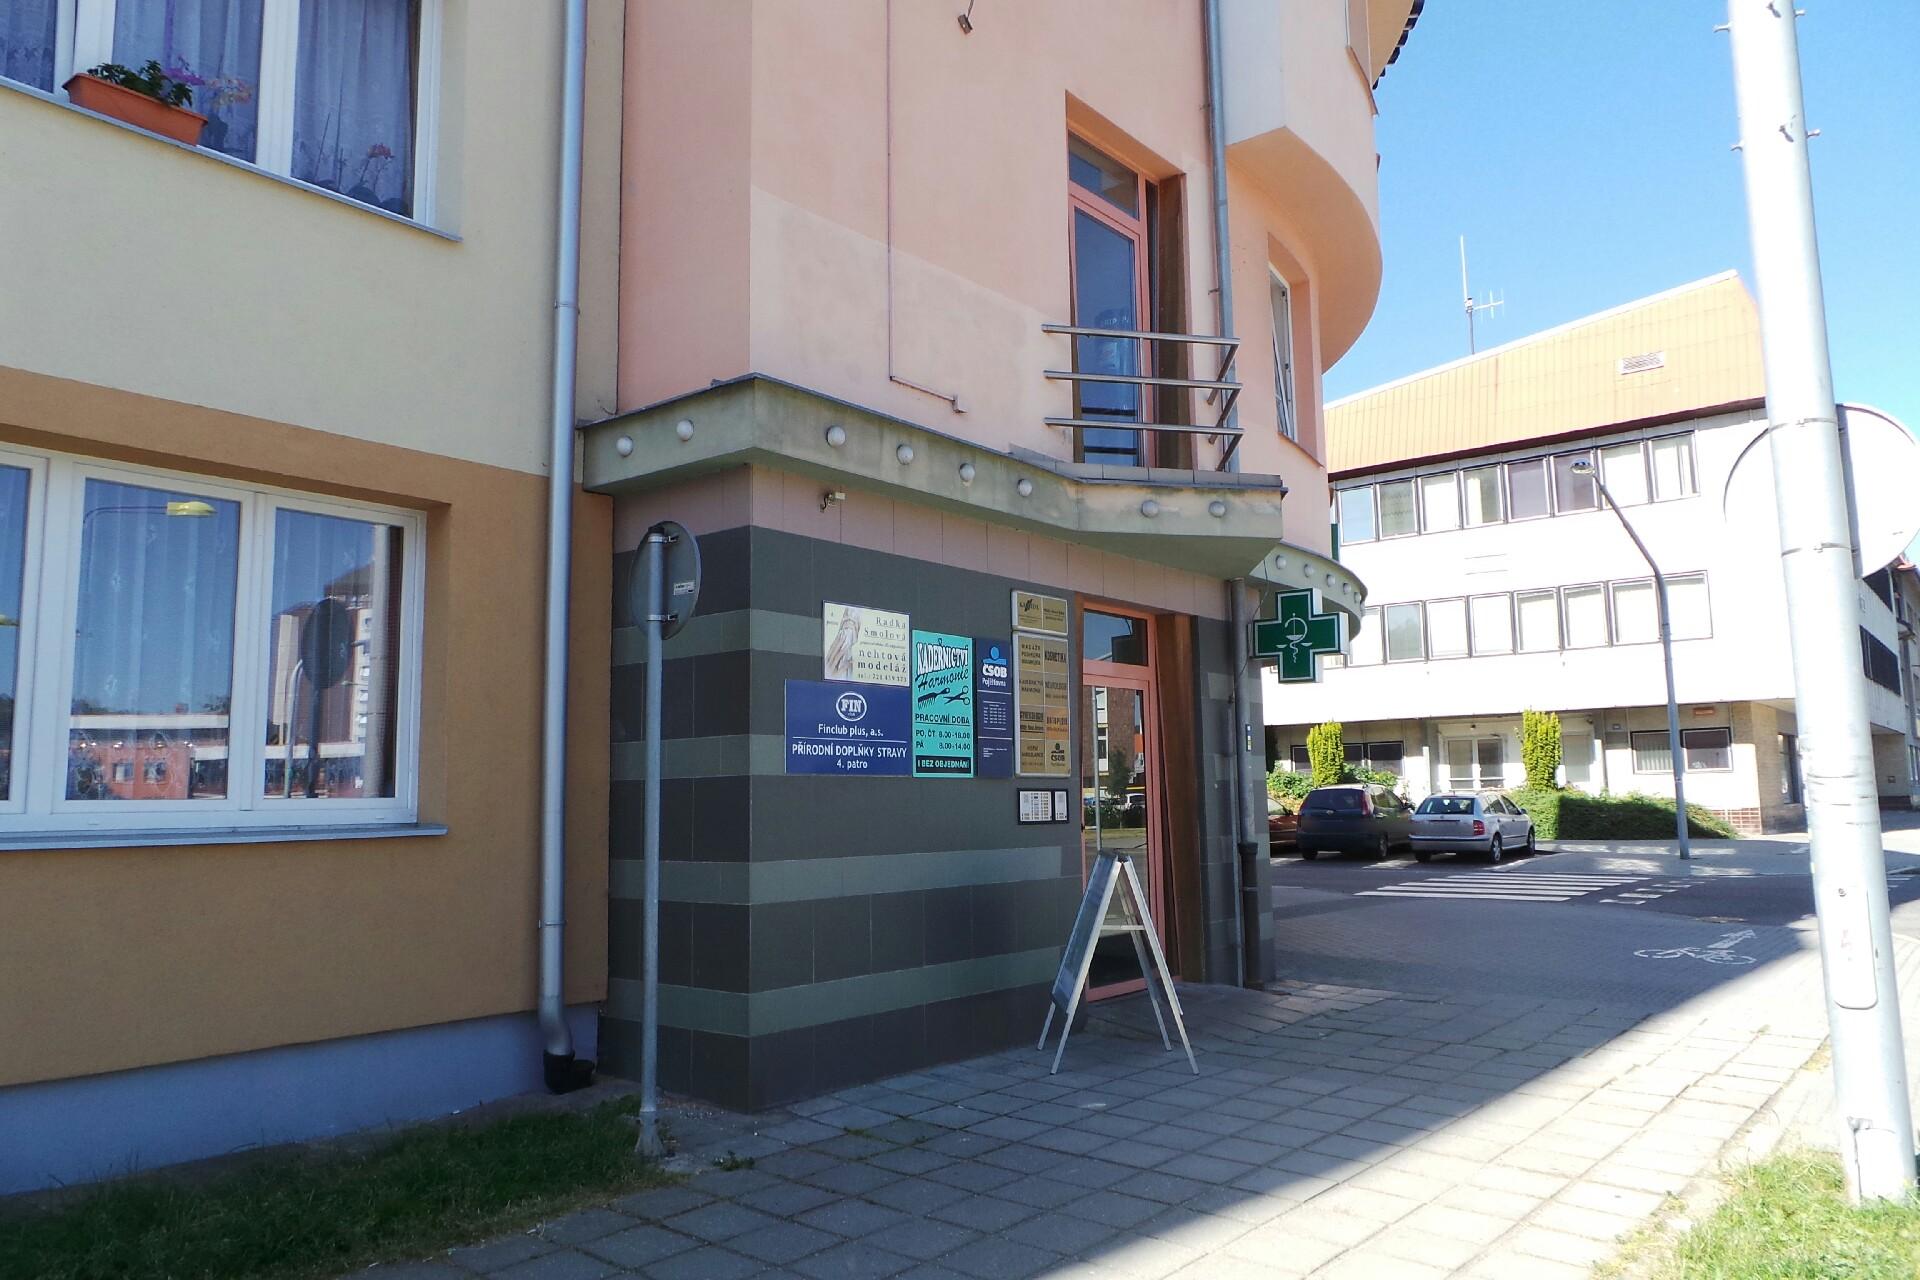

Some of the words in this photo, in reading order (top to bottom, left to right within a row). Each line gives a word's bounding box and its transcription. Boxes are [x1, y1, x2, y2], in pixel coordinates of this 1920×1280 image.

[876, 616, 906, 629] Radka
[859, 649, 906, 662] nehtová
[858, 661, 907, 673] modeláž
[982, 663, 1008, 678] ČSOB
[841, 699, 862, 713] FIN
[916, 713, 950, 723] PRACOVNÍ
[952, 715, 970, 724] DOBA
[818, 723, 848, 735] Finclub
[850, 725, 868, 737] plus,
[870, 728, 884, 737] a.s.
[792, 741, 834, 756] PŘÍRODNÍ
[836, 743, 874, 757] DOPLŇKY
[877, 747, 907, 758] STRAVY
[836, 758, 845, 769] 4.
[848, 759, 868, 770] patro
[922, 760, 934, 768] BEZ
